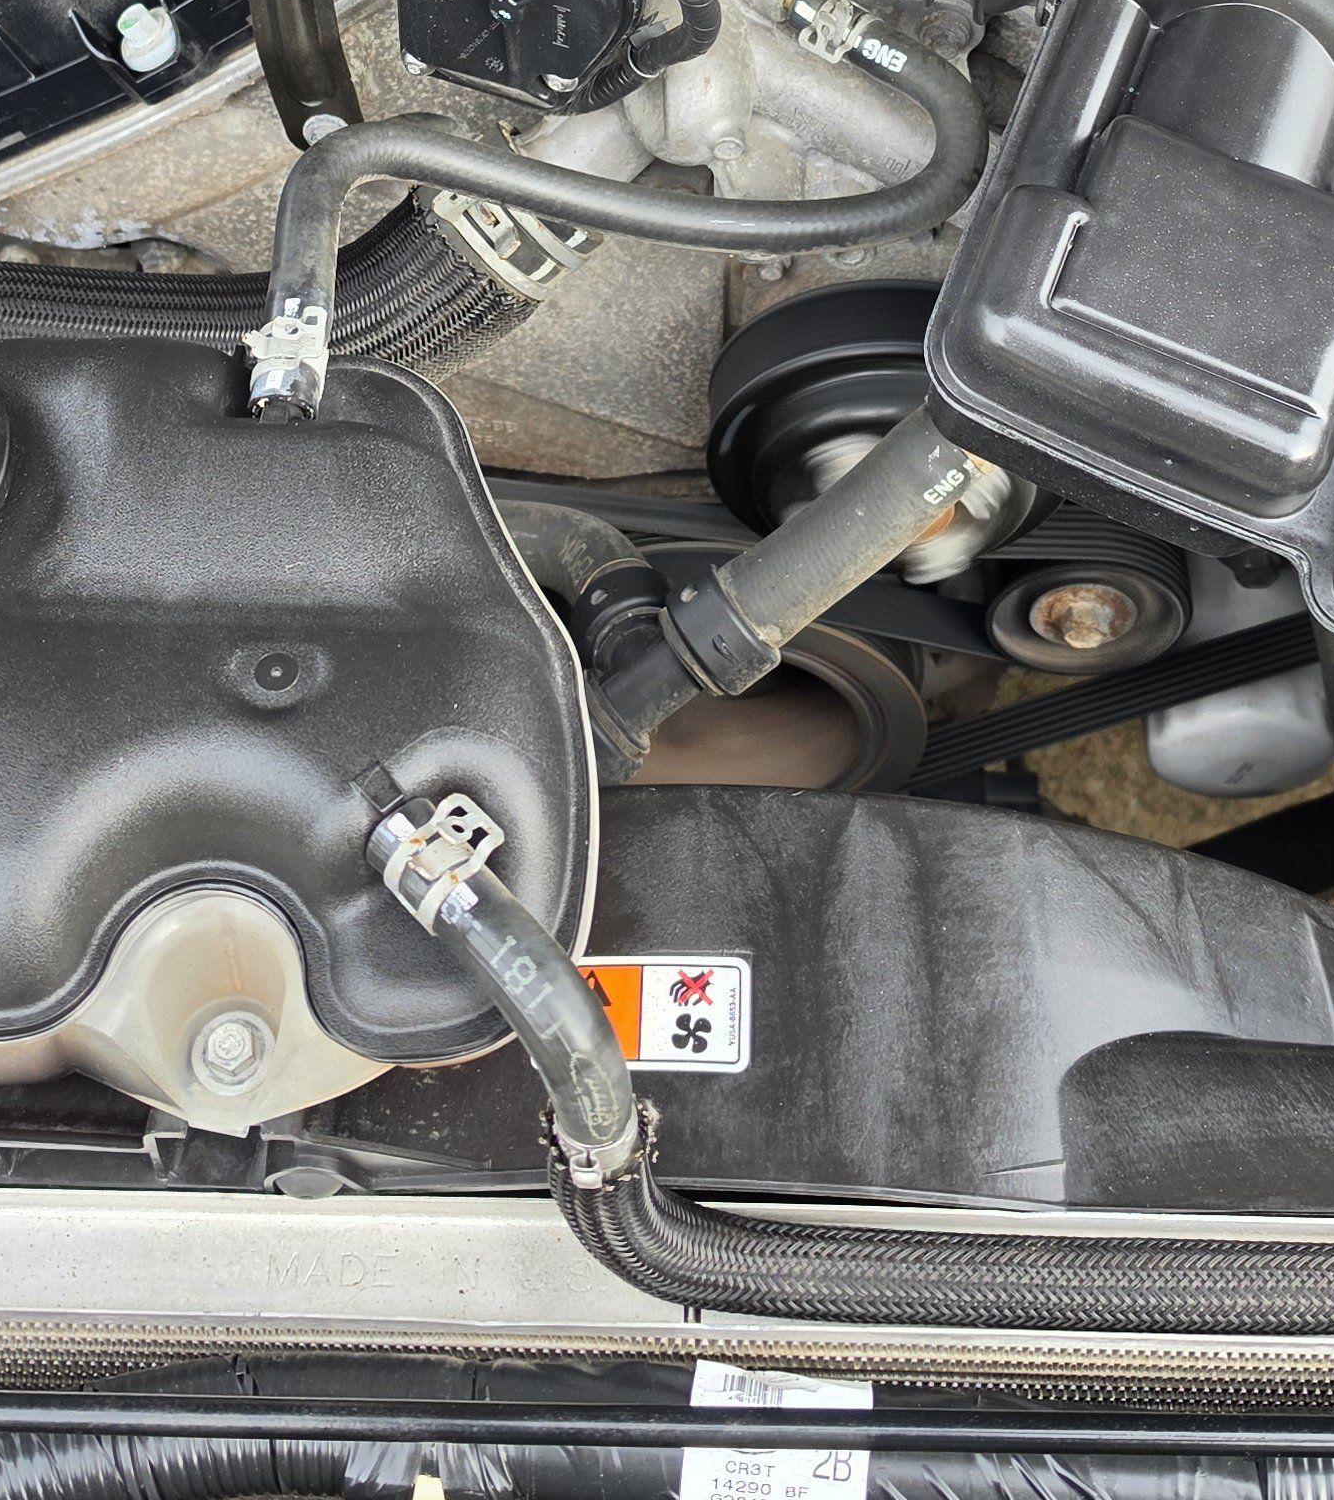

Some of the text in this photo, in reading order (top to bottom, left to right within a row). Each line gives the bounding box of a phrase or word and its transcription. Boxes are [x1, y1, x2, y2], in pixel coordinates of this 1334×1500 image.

[862, 38, 907, 73] ENG
[923, 471, 965, 506] ENG
[265, 1252, 400, 1288] MADE
[725, 1460, 776, 1478] CR3T
[812, 1451, 853, 1482] 2B
[711, 1477, 772, 1496] 14290
[785, 1486, 810, 1499] BF
